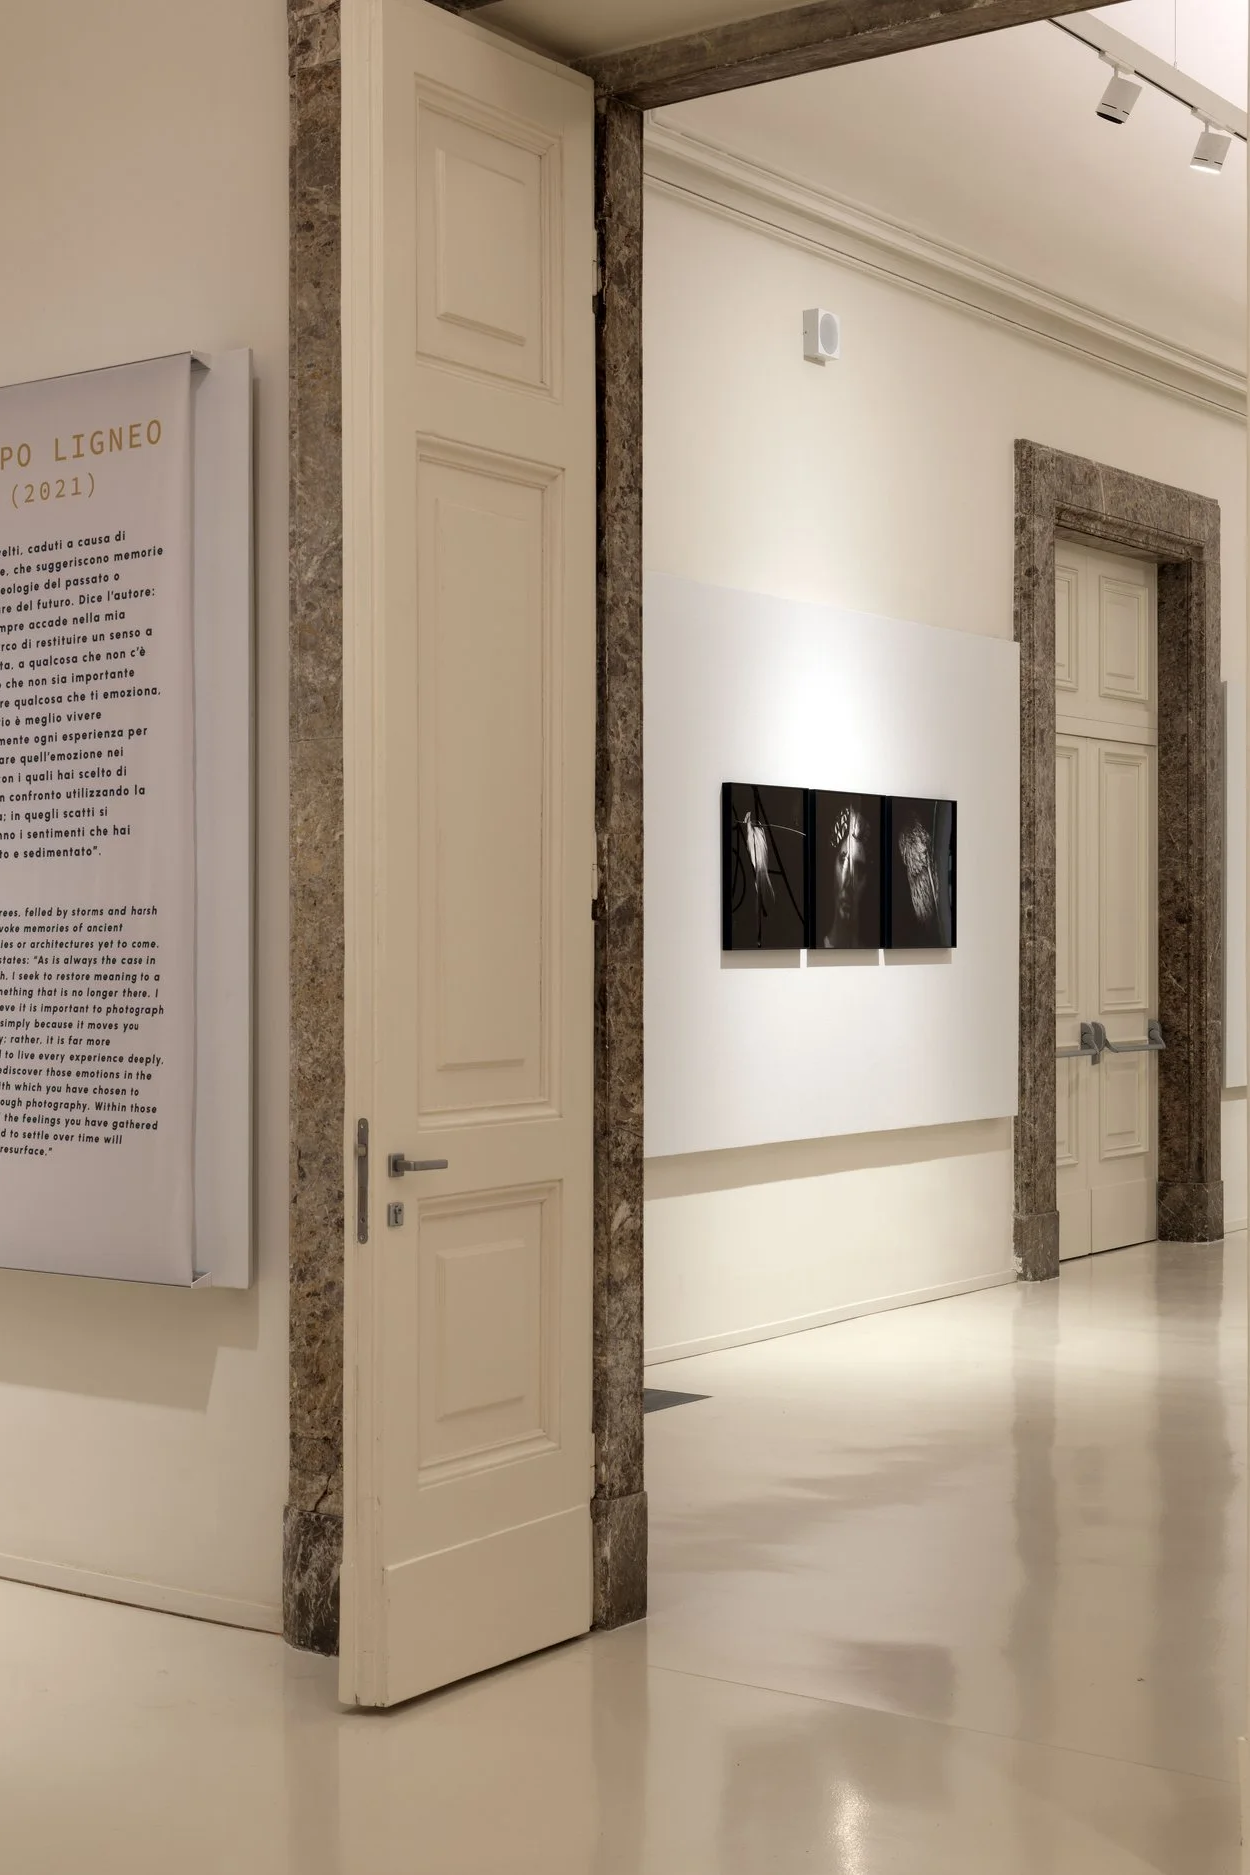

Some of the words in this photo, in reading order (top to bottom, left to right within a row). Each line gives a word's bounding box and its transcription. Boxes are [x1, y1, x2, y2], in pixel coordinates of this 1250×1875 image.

[55, 419, 161, 462] LIGNEO
[12, 472, 95, 509] (2021)
[27, 539, 62, 554] caduti
[66, 540, 74, 549] a
[77, 535, 110, 547] causa
[114, 530, 126, 542] di
[13, 563, 32, 575] che
[36, 555, 109, 573] suggeriscono
[113, 545, 163, 562] memorie
[43, 577, 61, 590] del
[65, 573, 109, 591] passato
[113, 573, 120, 581] o
[16, 600, 33, 612] del
[37, 598, 74, 610] futuro.
[79, 593, 103, 605] Dice
[28, 615, 68, 630] accade
[72, 612, 100, 625] nella
[104, 610, 126, 622] mia
[21, 638, 32, 650] di
[36, 633, 88, 648] restituire
[92, 633, 105, 642] un
[109, 629, 141, 640] senso
[145, 628, 153, 637] a
[18, 660, 25, 669] a
[28, 655, 78, 671] qualcosa
[82, 651, 102, 663] che
[106, 650, 126, 660] non
[5, 677, 24, 689] che
[28, 678, 47, 687] non
[51, 674, 67, 685] sia
[71, 668, 135, 685] importante
[14, 694, 63, 710] qualcosa
[67, 691, 86, 703] che
[90, 690, 98, 701] ti
[14, 716, 21, 726] è
[25, 712, 62, 727] meglio
[66, 711, 102, 722] vivere
[33, 732, 58, 746] ogni
[62, 729, 124, 744] esperienza
[128, 727, 148, 740] per
[107, 746, 124, 758] nei
[18, 772, 21, 783] i
[25, 770, 53, 785] quali
[57, 769, 74, 780] hai
[78, 767, 112, 779] scelto
[116, 765, 127, 777] di
[9, 790, 62, 802] confronto
[66, 785, 130, 799] utilizzando
[134, 784, 146, 796] la
[10, 811, 21, 821] in
[24, 808, 59, 823] quegli
[63, 807, 95, 819] scatti
[99, 806, 108, 817] si
[19, 829, 23, 840] i
[27, 826, 85, 839] sentimenti
[89, 825, 108, 837] che
[113, 824, 131, 836] hai
[13, 850, 19, 859] e
[25, 906, 53, 917] felled
[56, 906, 68, 919] by
[71, 907, 104, 917] storms
[107, 905, 127, 916] and
[131, 905, 158, 916] harsh
[23, 923, 69, 933] memories
[72, 922, 83, 933] of
[86, 923, 123, 932] ancient
[16, 941, 27, 949] or
[30, 939, 94, 949] architectures
[98, 939, 114, 952] yet
[117, 939, 128, 949] to
[131, 941, 159, 949] come.
[19, 1003, 26, 1012] it
[29, 1003, 37, 1013] is
[40, 1003, 89, 1015] important
[92, 1004, 103, 1014] to
[105, 1004, 164, 1017] photograph
[0, 1018, 31, 1031] simply
[34, 1018, 73, 1029] because
[76, 1020, 84, 1029] it
[87, 1022, 119, 1030] moves
[123, 1023, 139, 1033] you
[5, 1050, 14, 1059] to
[17, 1049, 35, 1060] live
[38, 1053, 66, 1064] every
[69, 1053, 124, 1065] experience
[14, 1081, 42, 1092] which
[46, 1085, 62, 1095] you
[65, 1083, 89, 1094] have
[92, 1085, 127, 1096] chosen
[130, 1087, 139, 1097] to
[25, 1098, 90, 1113] photography.
[95, 1101, 127, 1112] Within
[130, 1103, 157, 1114] those
[10, 1129, 19, 1138] to
[22, 1130, 50, 1140] settle
[53, 1133, 75, 1142] over
[78, 1133, 100, 1143] time
[103, 1134, 123, 1145] will
